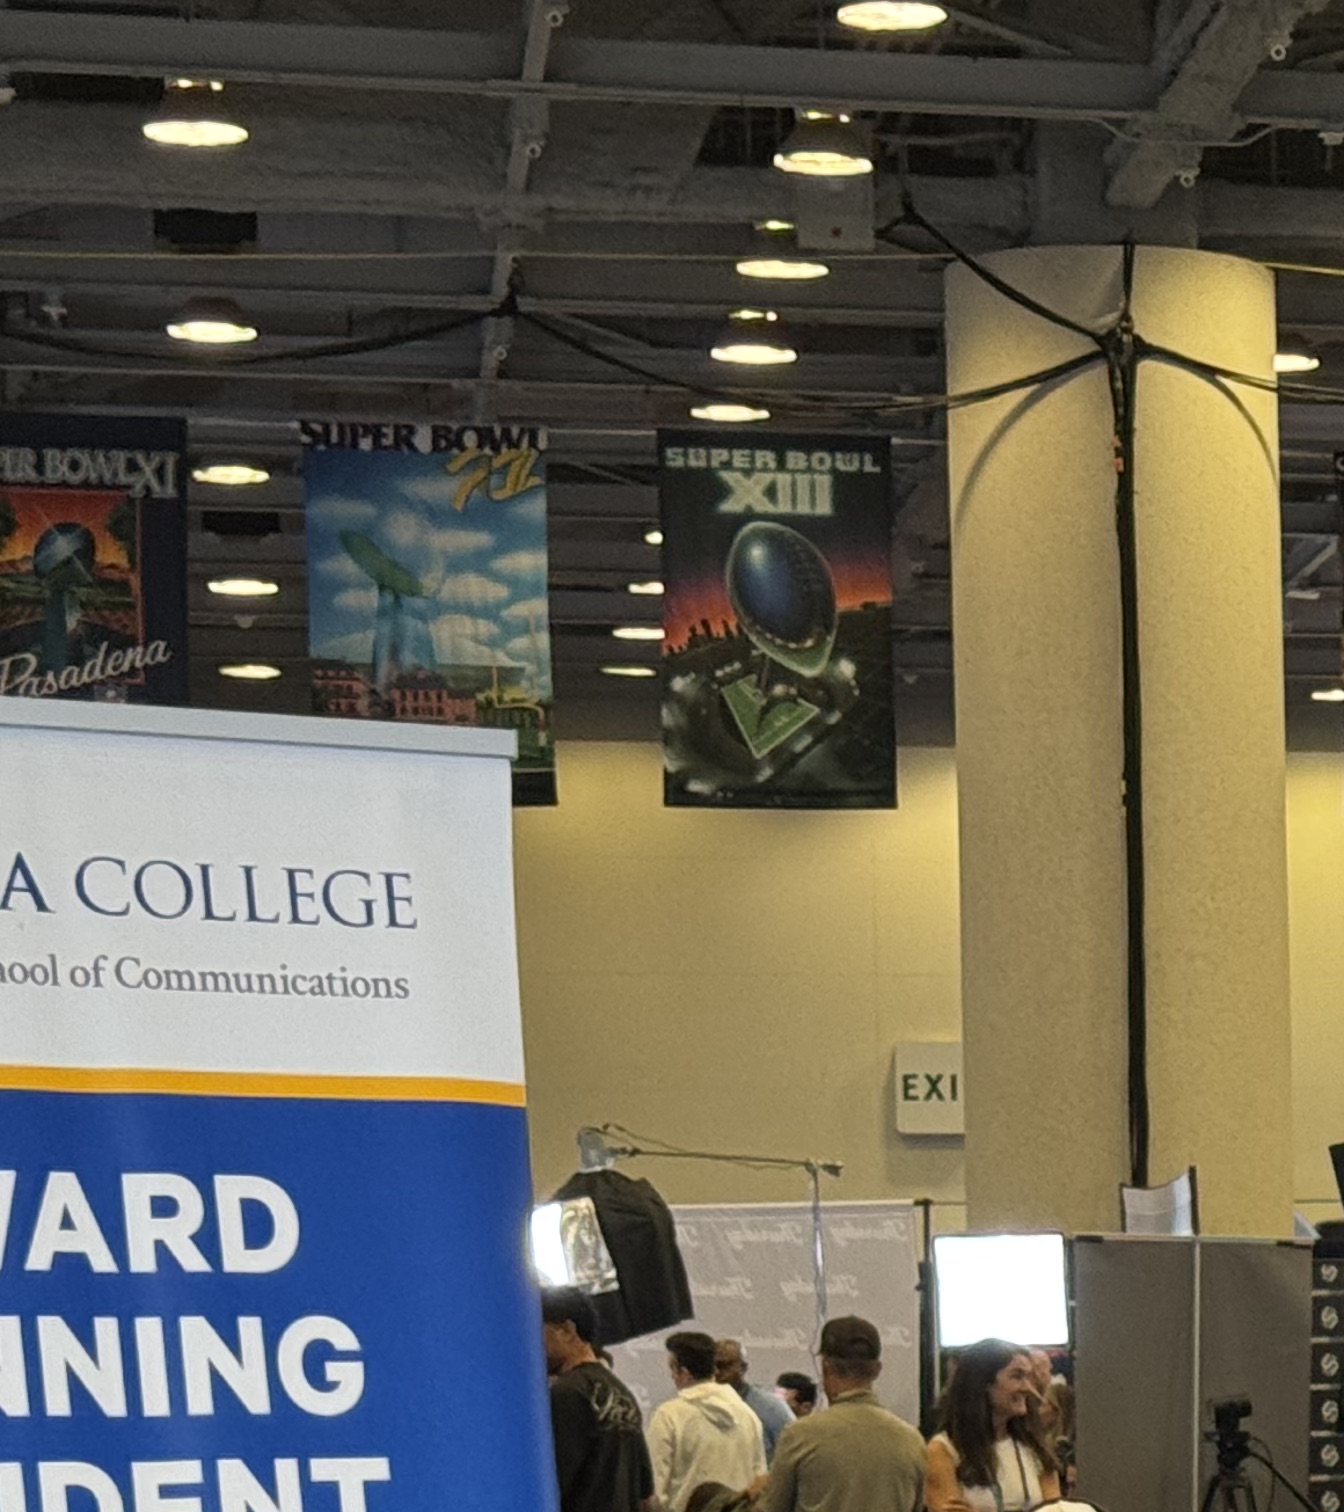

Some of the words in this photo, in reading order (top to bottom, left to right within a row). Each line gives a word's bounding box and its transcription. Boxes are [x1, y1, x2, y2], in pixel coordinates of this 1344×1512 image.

[301, 422, 417, 451] SUPER
[43, 449, 132, 486] BOWL
[129, 451, 180, 499] XI
[664, 447, 777, 470] SUPER
[785, 450, 882, 474] BOWL
[717, 469, 834, 516] XIII
[0, 639, 173, 698] Pasadena
[75, 856, 418, 930] COLLEGE
[70, 954, 108, 990] of
[114, 955, 411, 1000] Communications
